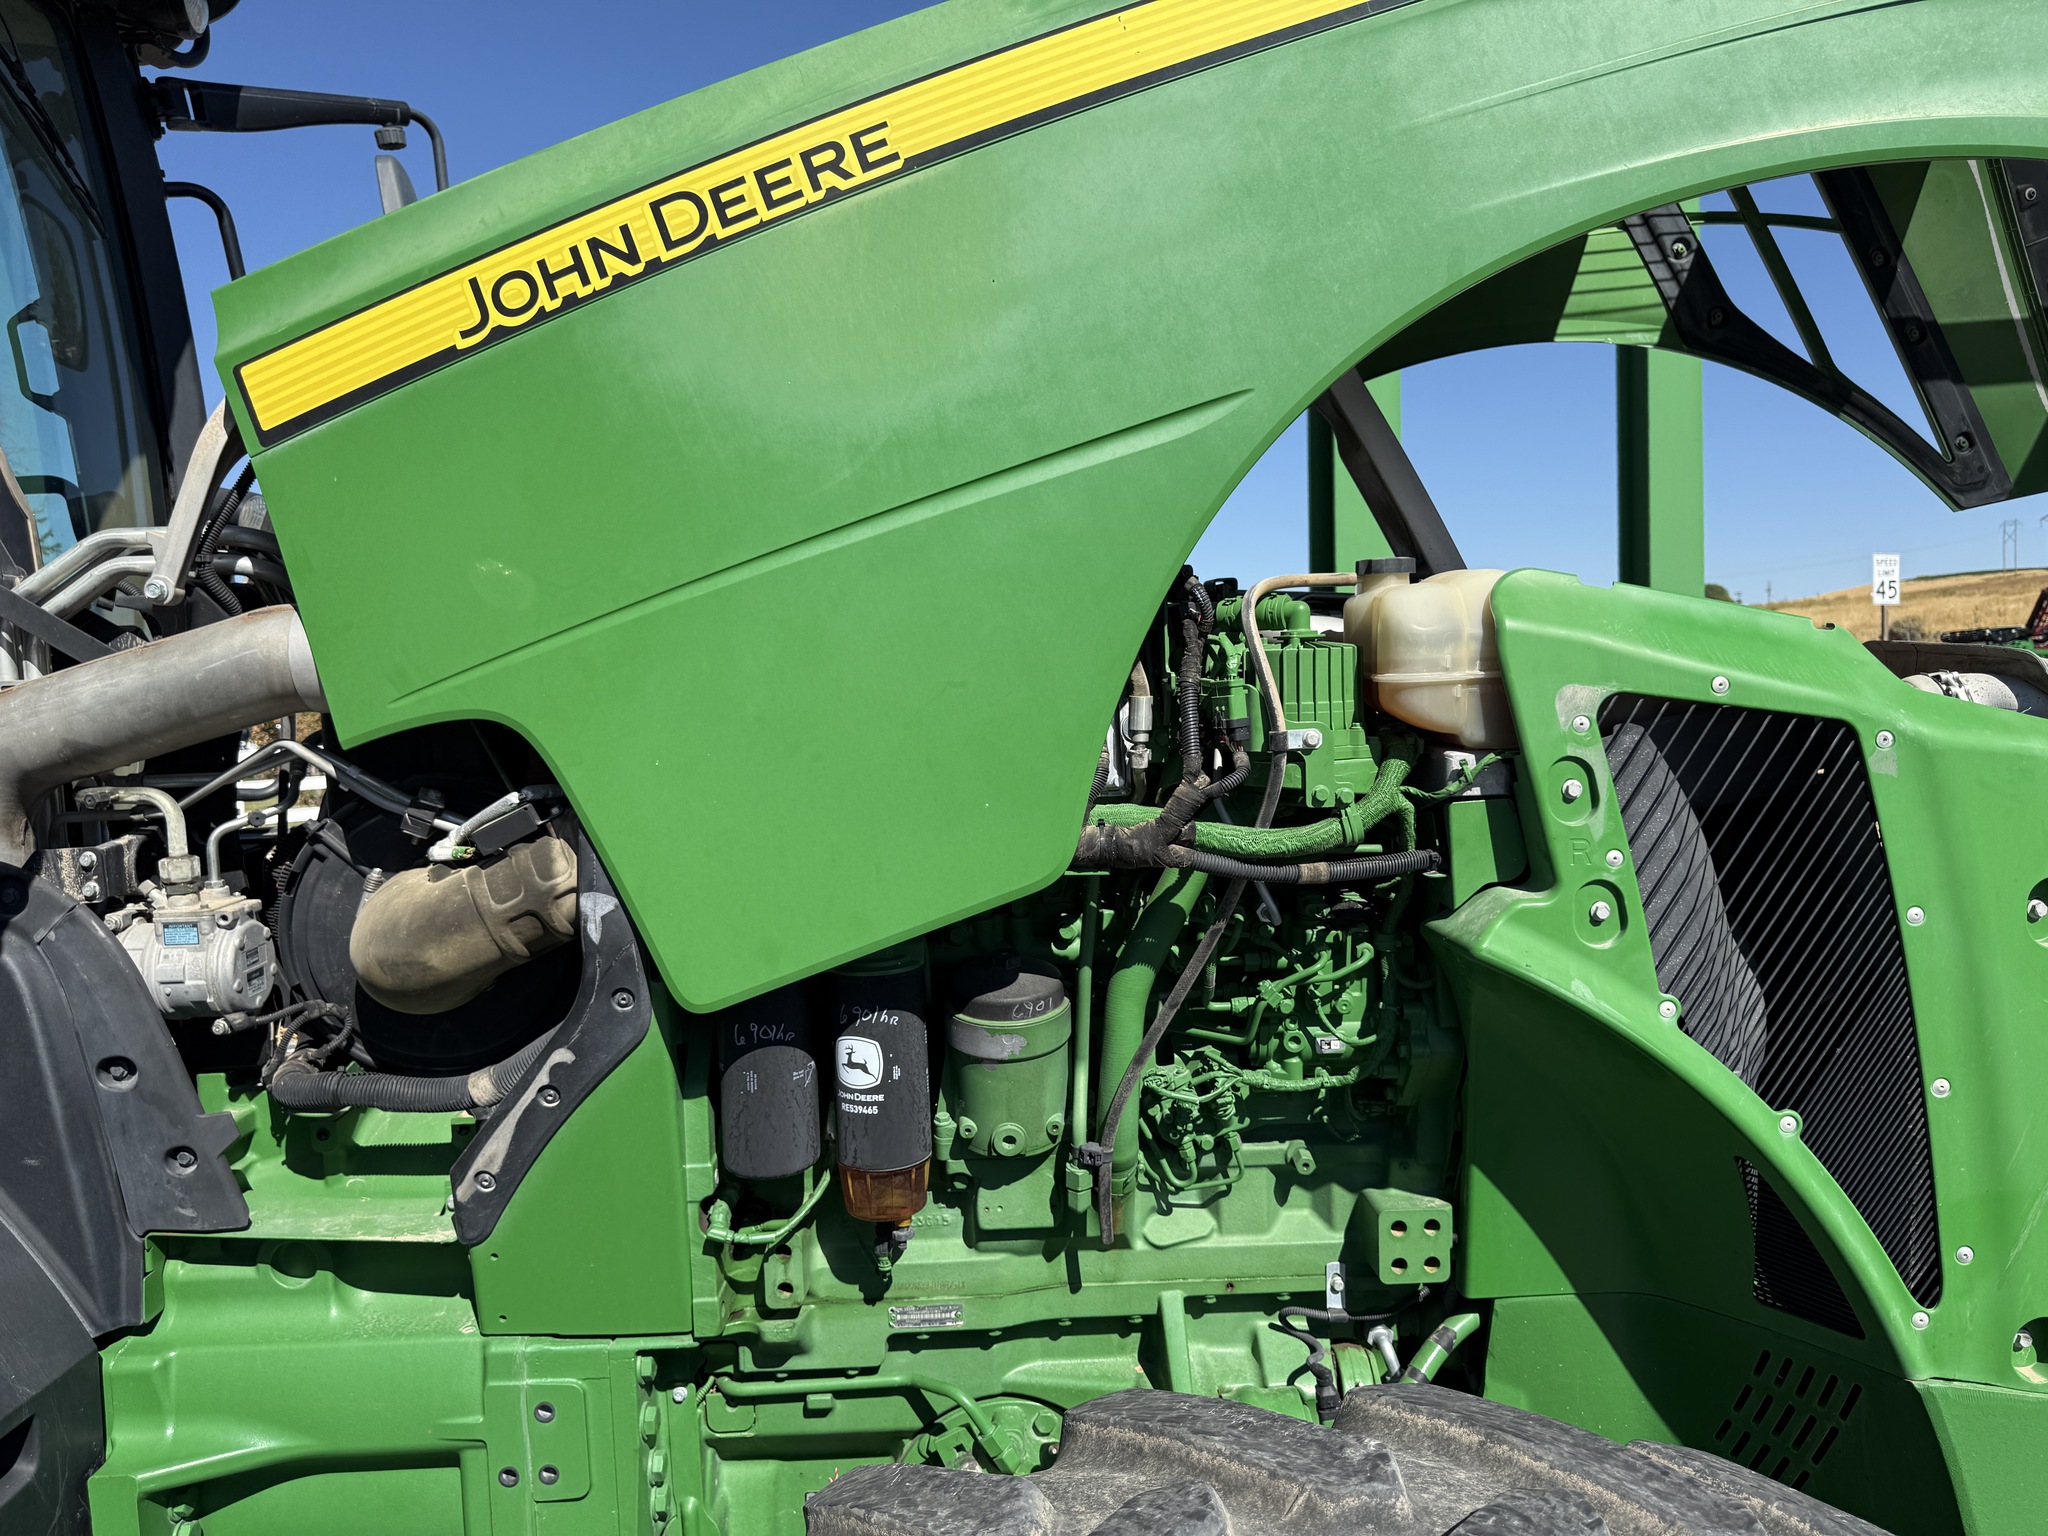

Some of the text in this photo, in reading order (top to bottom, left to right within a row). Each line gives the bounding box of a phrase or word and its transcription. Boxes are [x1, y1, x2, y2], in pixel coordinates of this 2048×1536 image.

[458, 120, 902, 341] JOHN DEERE
[1875, 558, 1898, 567] SPEED
[1877, 568, 1895, 577] LIMIT
[1876, 580, 1898, 599] 45
[1570, 837, 1592, 866] R
[1012, 997, 1053, 1019] 6901
[854, 1092, 885, 1102] DEERE
[841, 1102, 879, 1115] RE539465
